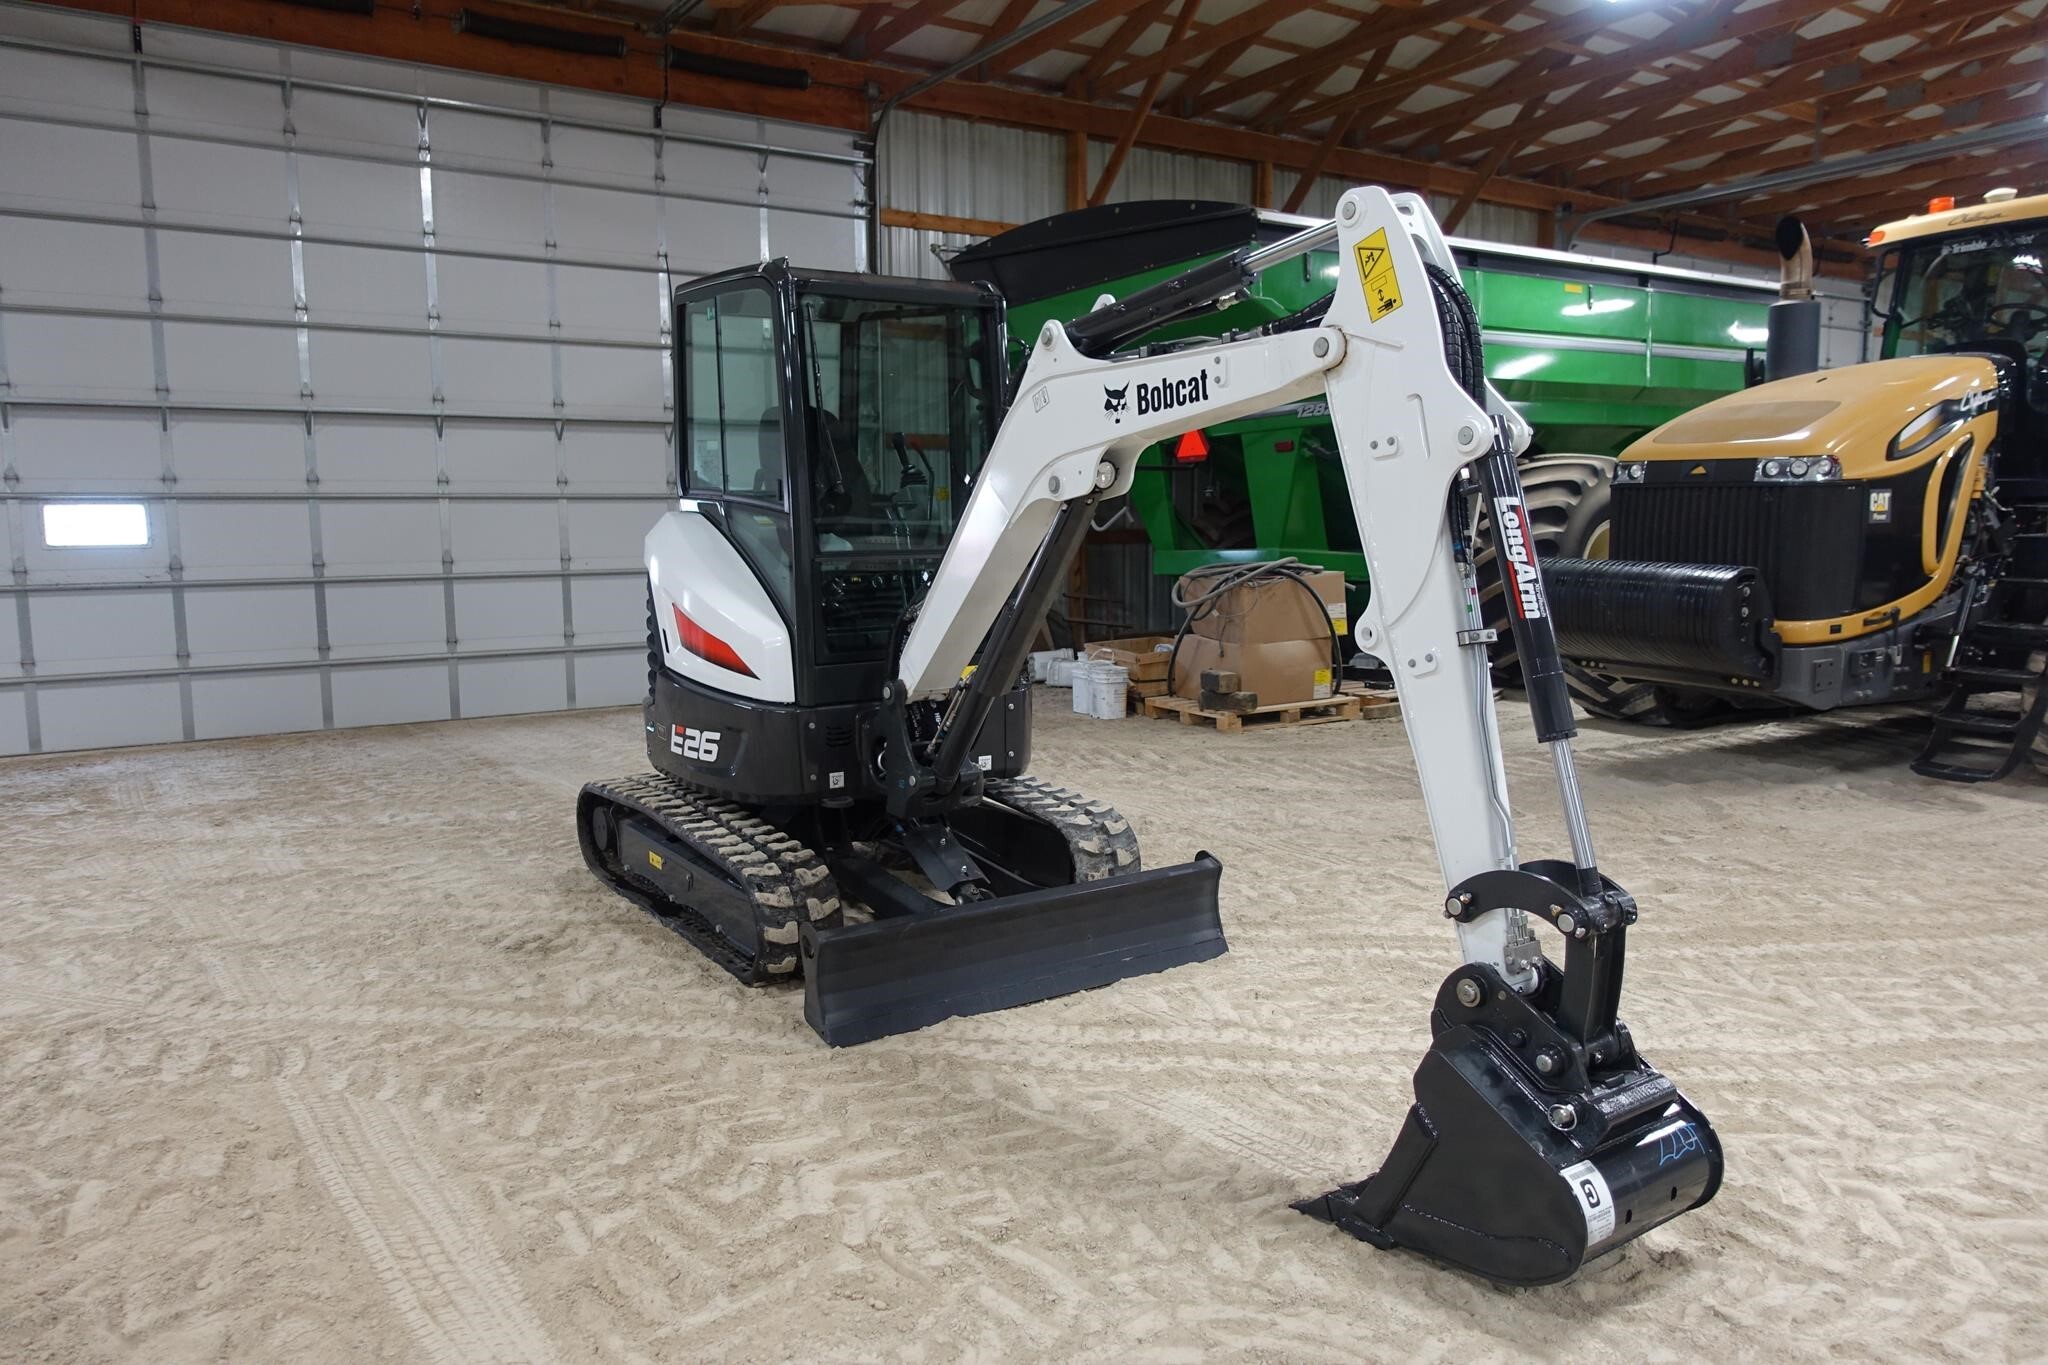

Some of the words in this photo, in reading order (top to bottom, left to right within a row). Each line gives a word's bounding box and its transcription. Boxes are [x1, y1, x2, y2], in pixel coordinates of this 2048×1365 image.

[1136, 369, 1209, 416] Bobcat
[1870, 492, 1891, 511] CAT
[1494, 497, 1541, 619] LongArm
[671, 724, 722, 762] E26
